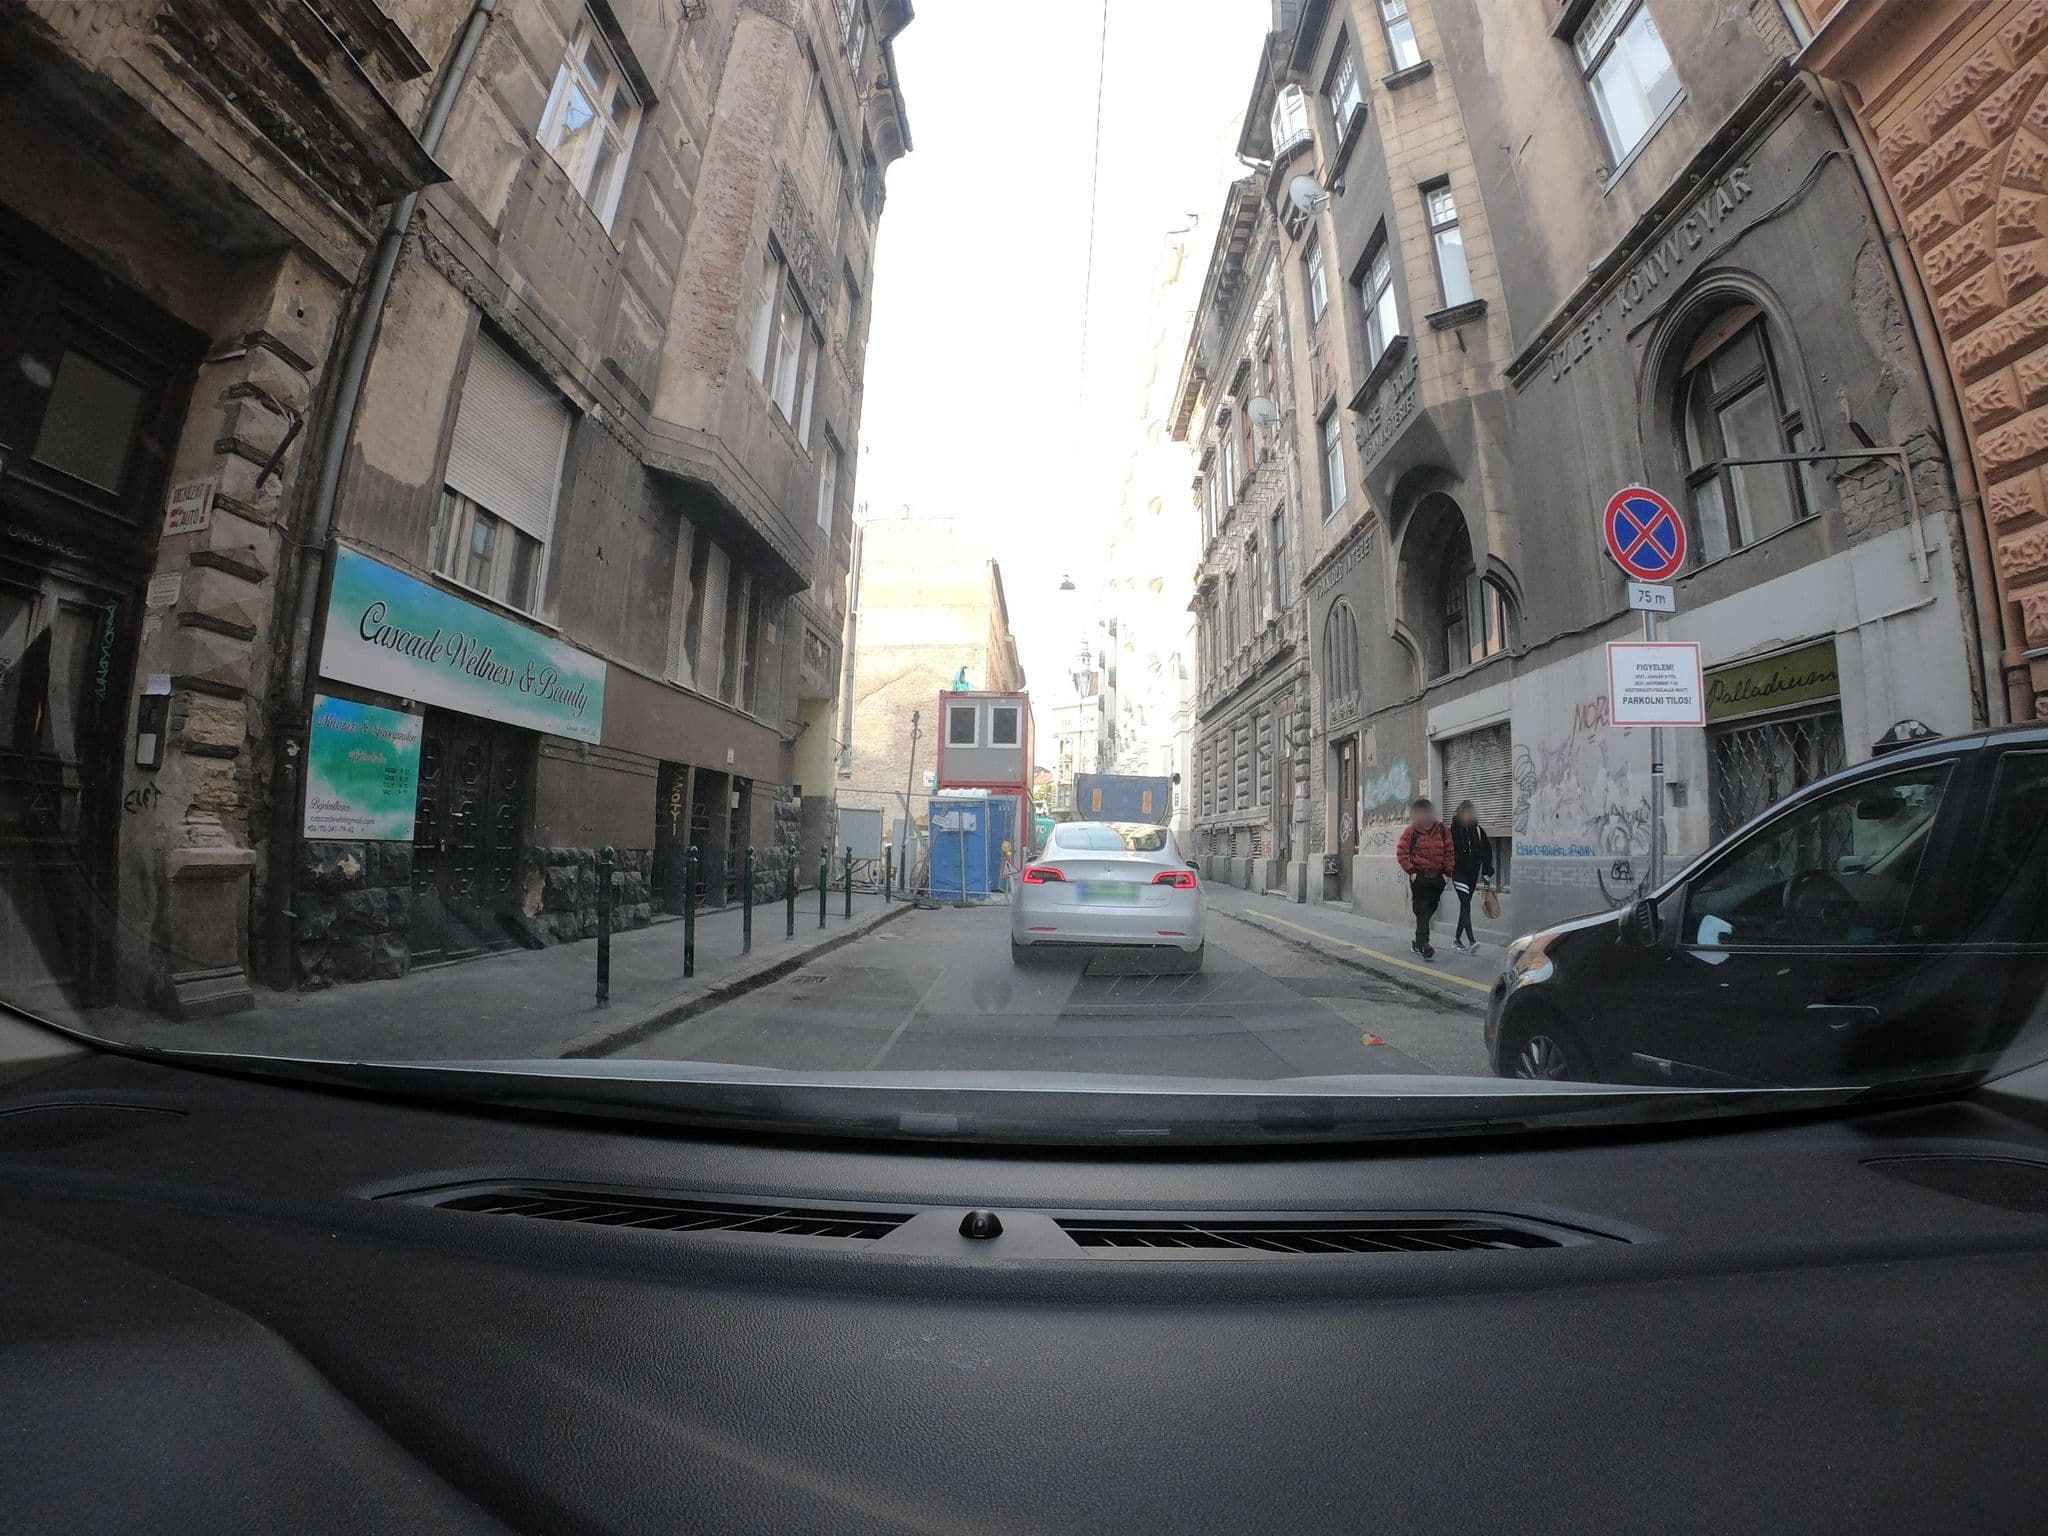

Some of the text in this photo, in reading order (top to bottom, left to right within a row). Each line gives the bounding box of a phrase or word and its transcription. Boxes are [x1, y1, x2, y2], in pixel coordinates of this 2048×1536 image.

[1637, 589, 1666, 604] 75 m
[359, 601, 590, 718] Cascade Wellness & Beauty
[1622, 696, 1692, 705] PARKOLNI TILOS!
